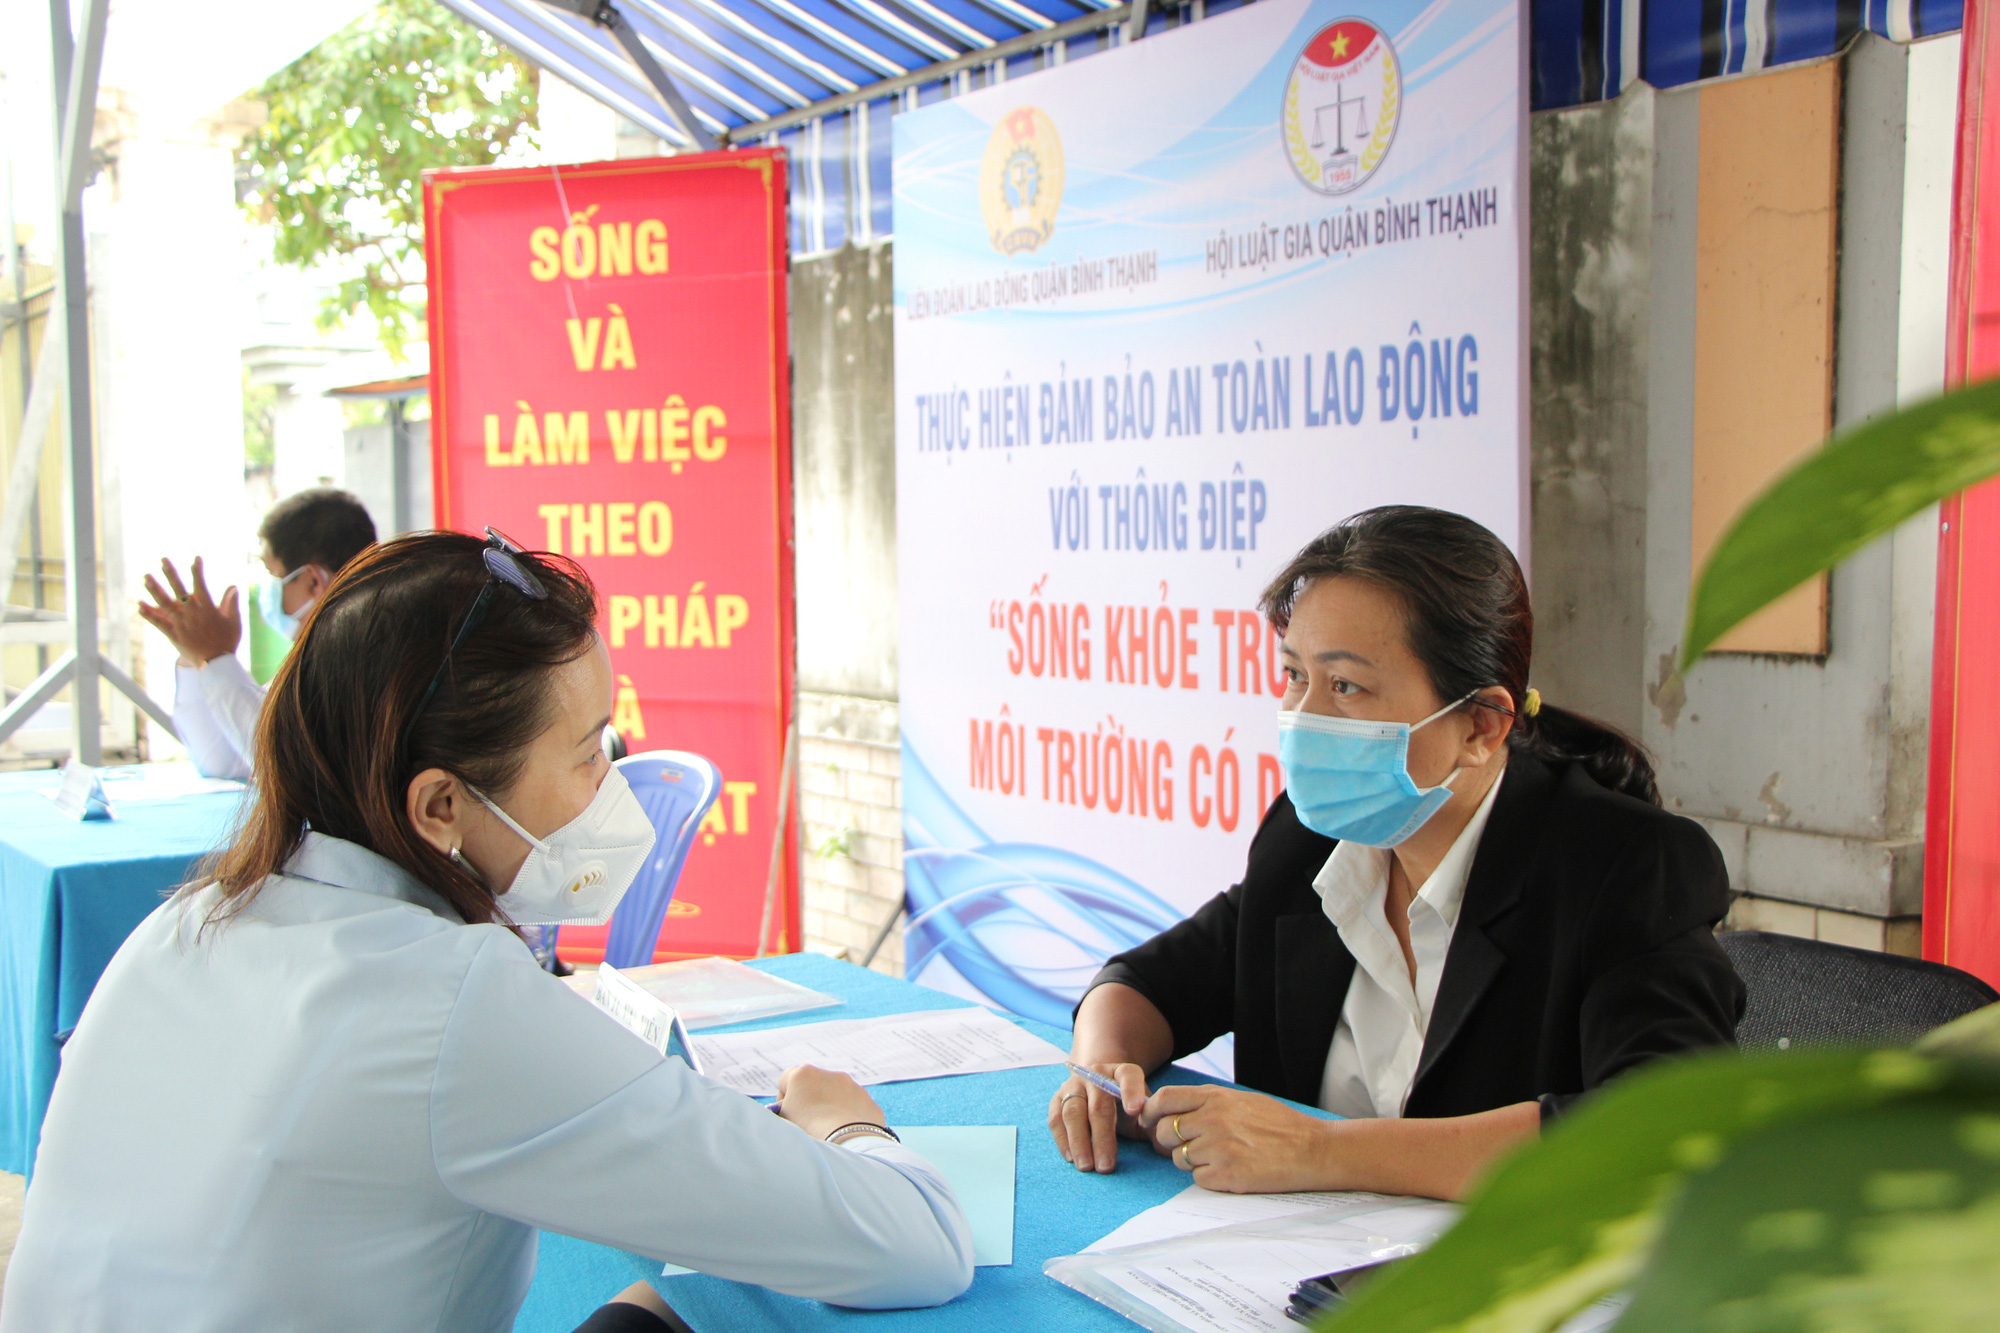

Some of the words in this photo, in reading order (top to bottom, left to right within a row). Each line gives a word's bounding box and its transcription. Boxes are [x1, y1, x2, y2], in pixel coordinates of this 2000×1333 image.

[530, 204, 669, 282] SỐNG
[1206, 230, 1233, 278] HỘI
[1238, 222, 1279, 271] LUẬT
[1283, 223, 1313, 261] GIA
[1318, 204, 1369, 258] QUẬN
[1375, 197, 1420, 245] BÌNH
[1426, 186, 1498, 240] THẠNH
[967, 279, 991, 312] LAO
[993, 269, 1028, 312] ĐỘNG
[1031, 260, 1068, 305] QUẬN
[1070, 255, 1103, 295] BÌNH
[1106, 249, 1158, 293] THẠNH
[565, 303, 637, 372] VÀ
[915, 382, 970, 466] THỰC
[979, 369, 1030, 463] HIỆN
[1038, 359, 1094, 446] ĐẢM
[1103, 352, 1155, 441] BẢO
[1165, 365, 1202, 438] AN
[1212, 340, 1291, 434] TOÀN
[1304, 346, 1365, 428] LAO
[1377, 320, 1479, 440] ĐỘNG
[484, 400, 591, 467] LÀM
[605, 394, 728, 475] VIỆC
[538, 501, 674, 557] THEO
[1049, 468, 1090, 552] VỚI
[1098, 465, 1188, 552] THÔNG
[1198, 460, 1267, 569] ĐIỆP
[608, 582, 750, 649] PHÁP
[1104, 579, 1200, 690] KHỎE
[969, 702, 1026, 798] MÔI
[1036, 713, 1174, 822] TRƯỜNG
[1188, 726, 1240, 834] CÓ
